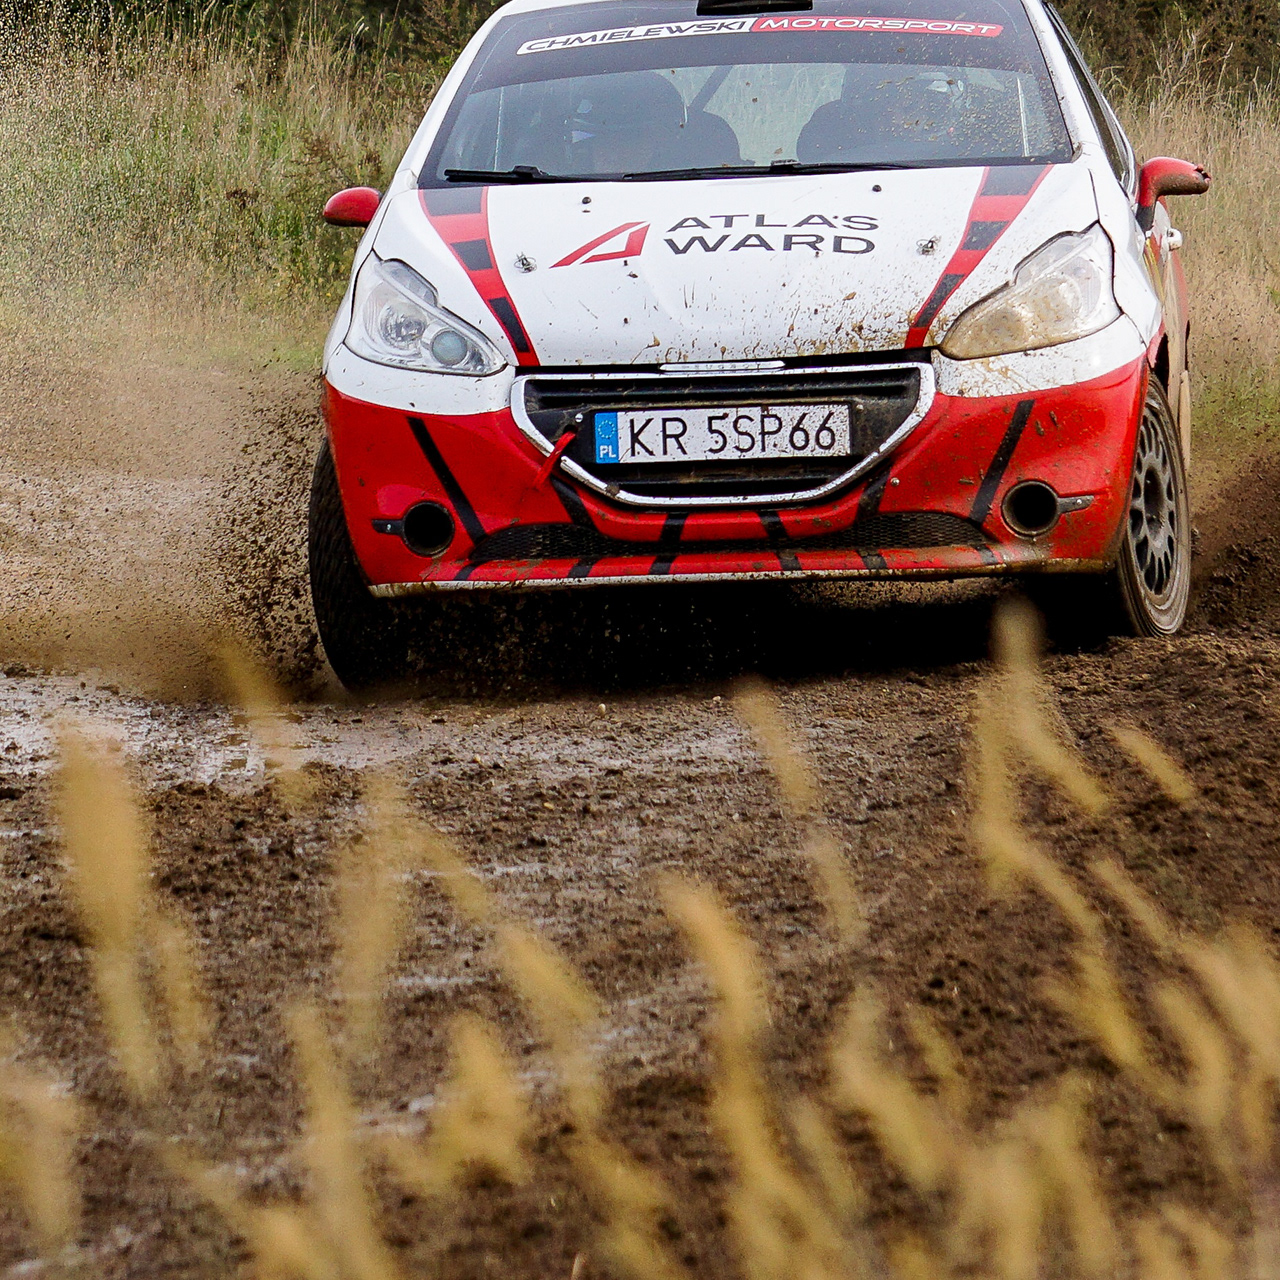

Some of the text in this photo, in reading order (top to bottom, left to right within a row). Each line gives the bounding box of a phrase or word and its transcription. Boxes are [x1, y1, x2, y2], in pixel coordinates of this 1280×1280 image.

[524, 18, 998, 52] CHMIELEWSKI MOTORSPORT
[665, 214, 880, 233] ATLAS
[663, 233, 876, 255] WARD
[628, 411, 836, 457] KR 5SP66
[599, 445, 617, 459] PL
